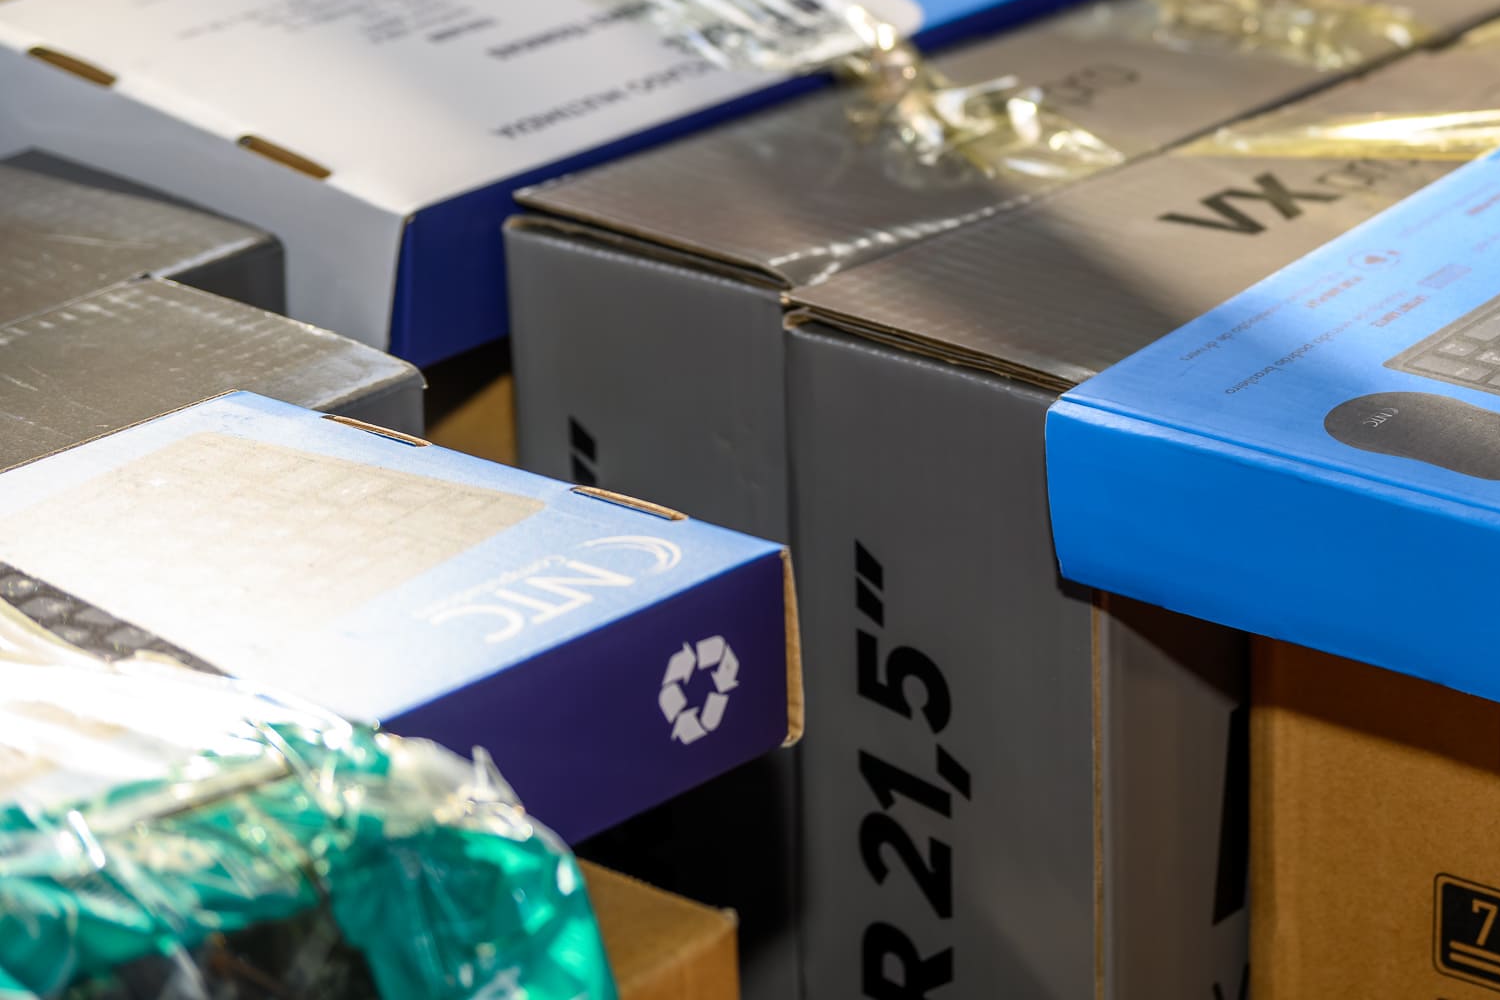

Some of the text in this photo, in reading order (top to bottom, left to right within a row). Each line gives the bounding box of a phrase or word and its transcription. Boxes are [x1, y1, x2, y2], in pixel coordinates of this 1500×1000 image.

[1157, 172, 1340, 236] VX
[1224, 365, 1281, 395] brasileiro
[1362, 410, 1391, 428] NTC
[430, 559, 636, 645] NTC
[854, 539, 972, 919] 21,5"
[1470, 898, 1498, 947] 7
